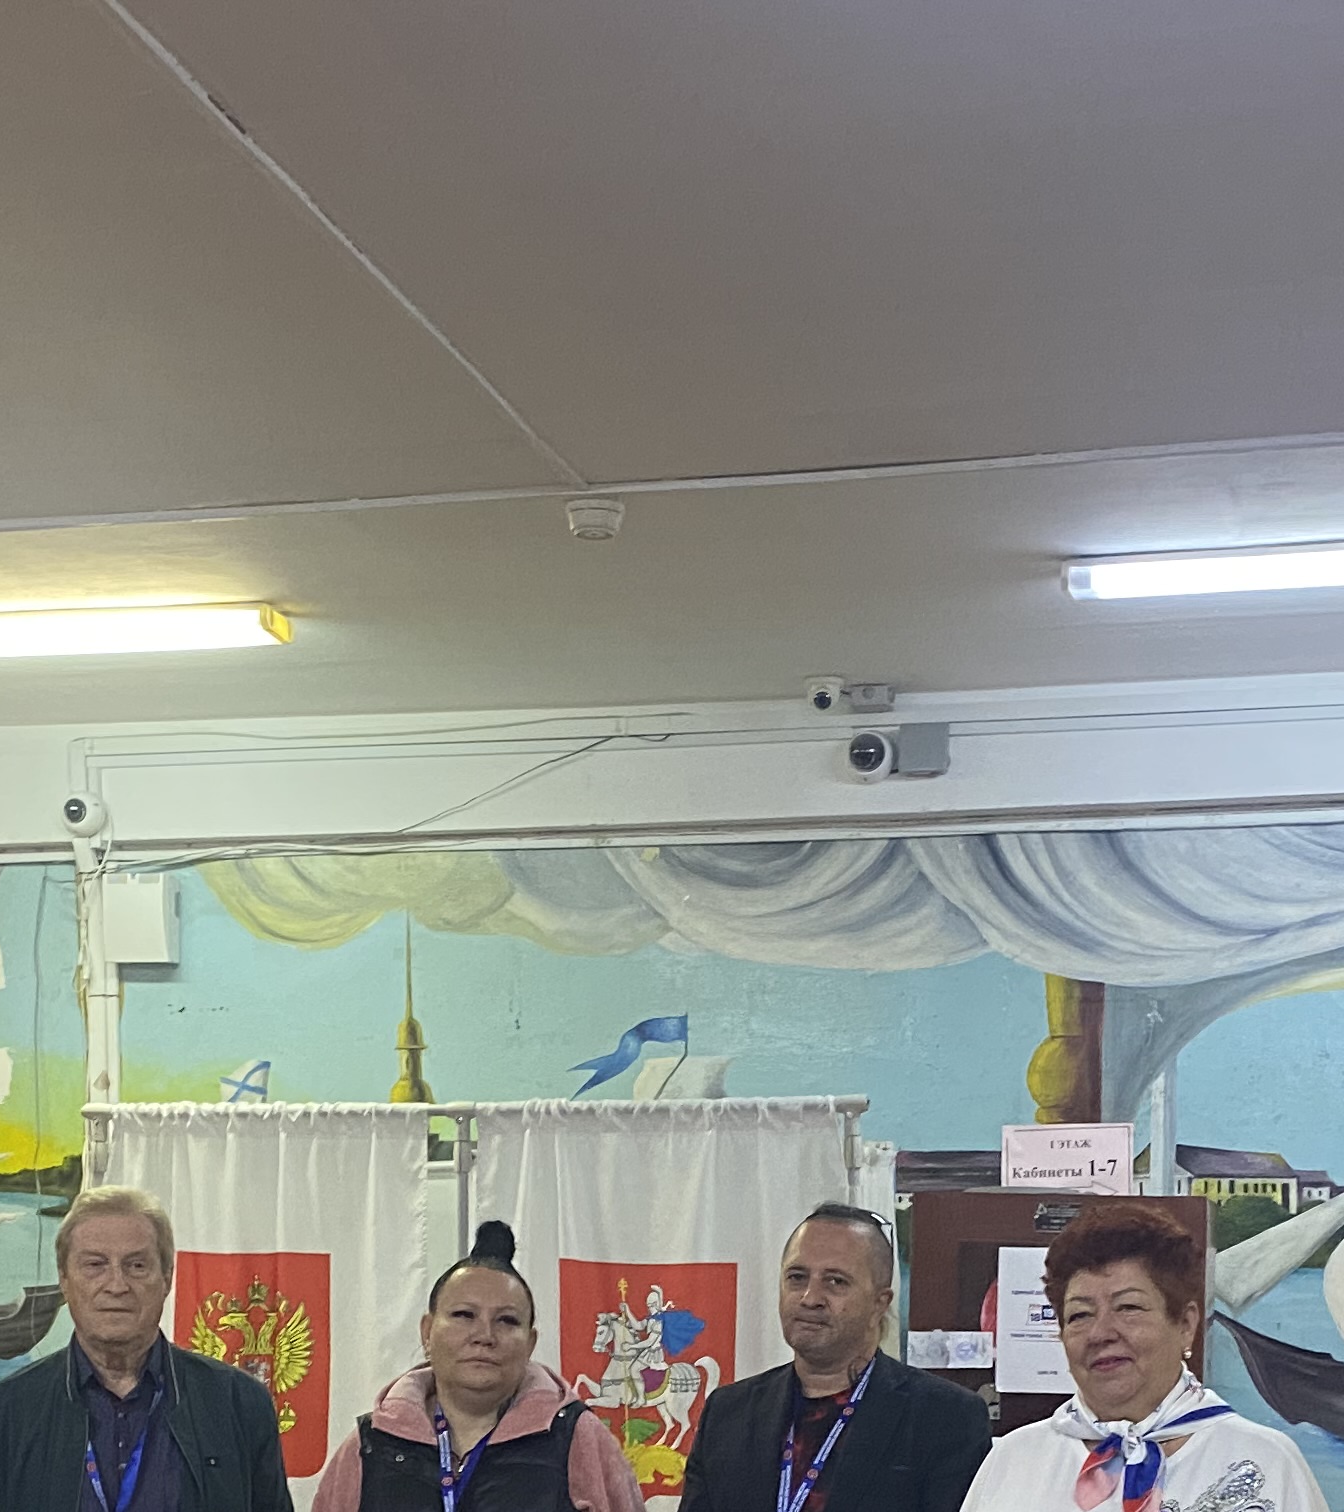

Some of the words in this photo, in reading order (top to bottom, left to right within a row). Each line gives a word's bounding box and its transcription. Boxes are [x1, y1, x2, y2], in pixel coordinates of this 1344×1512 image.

[1057, 1139, 1092, 1149] ЭТАЖ
[1012, 1166, 1083, 1179] Кабинеты
[1088, 1159, 1118, 1176] 1-7
